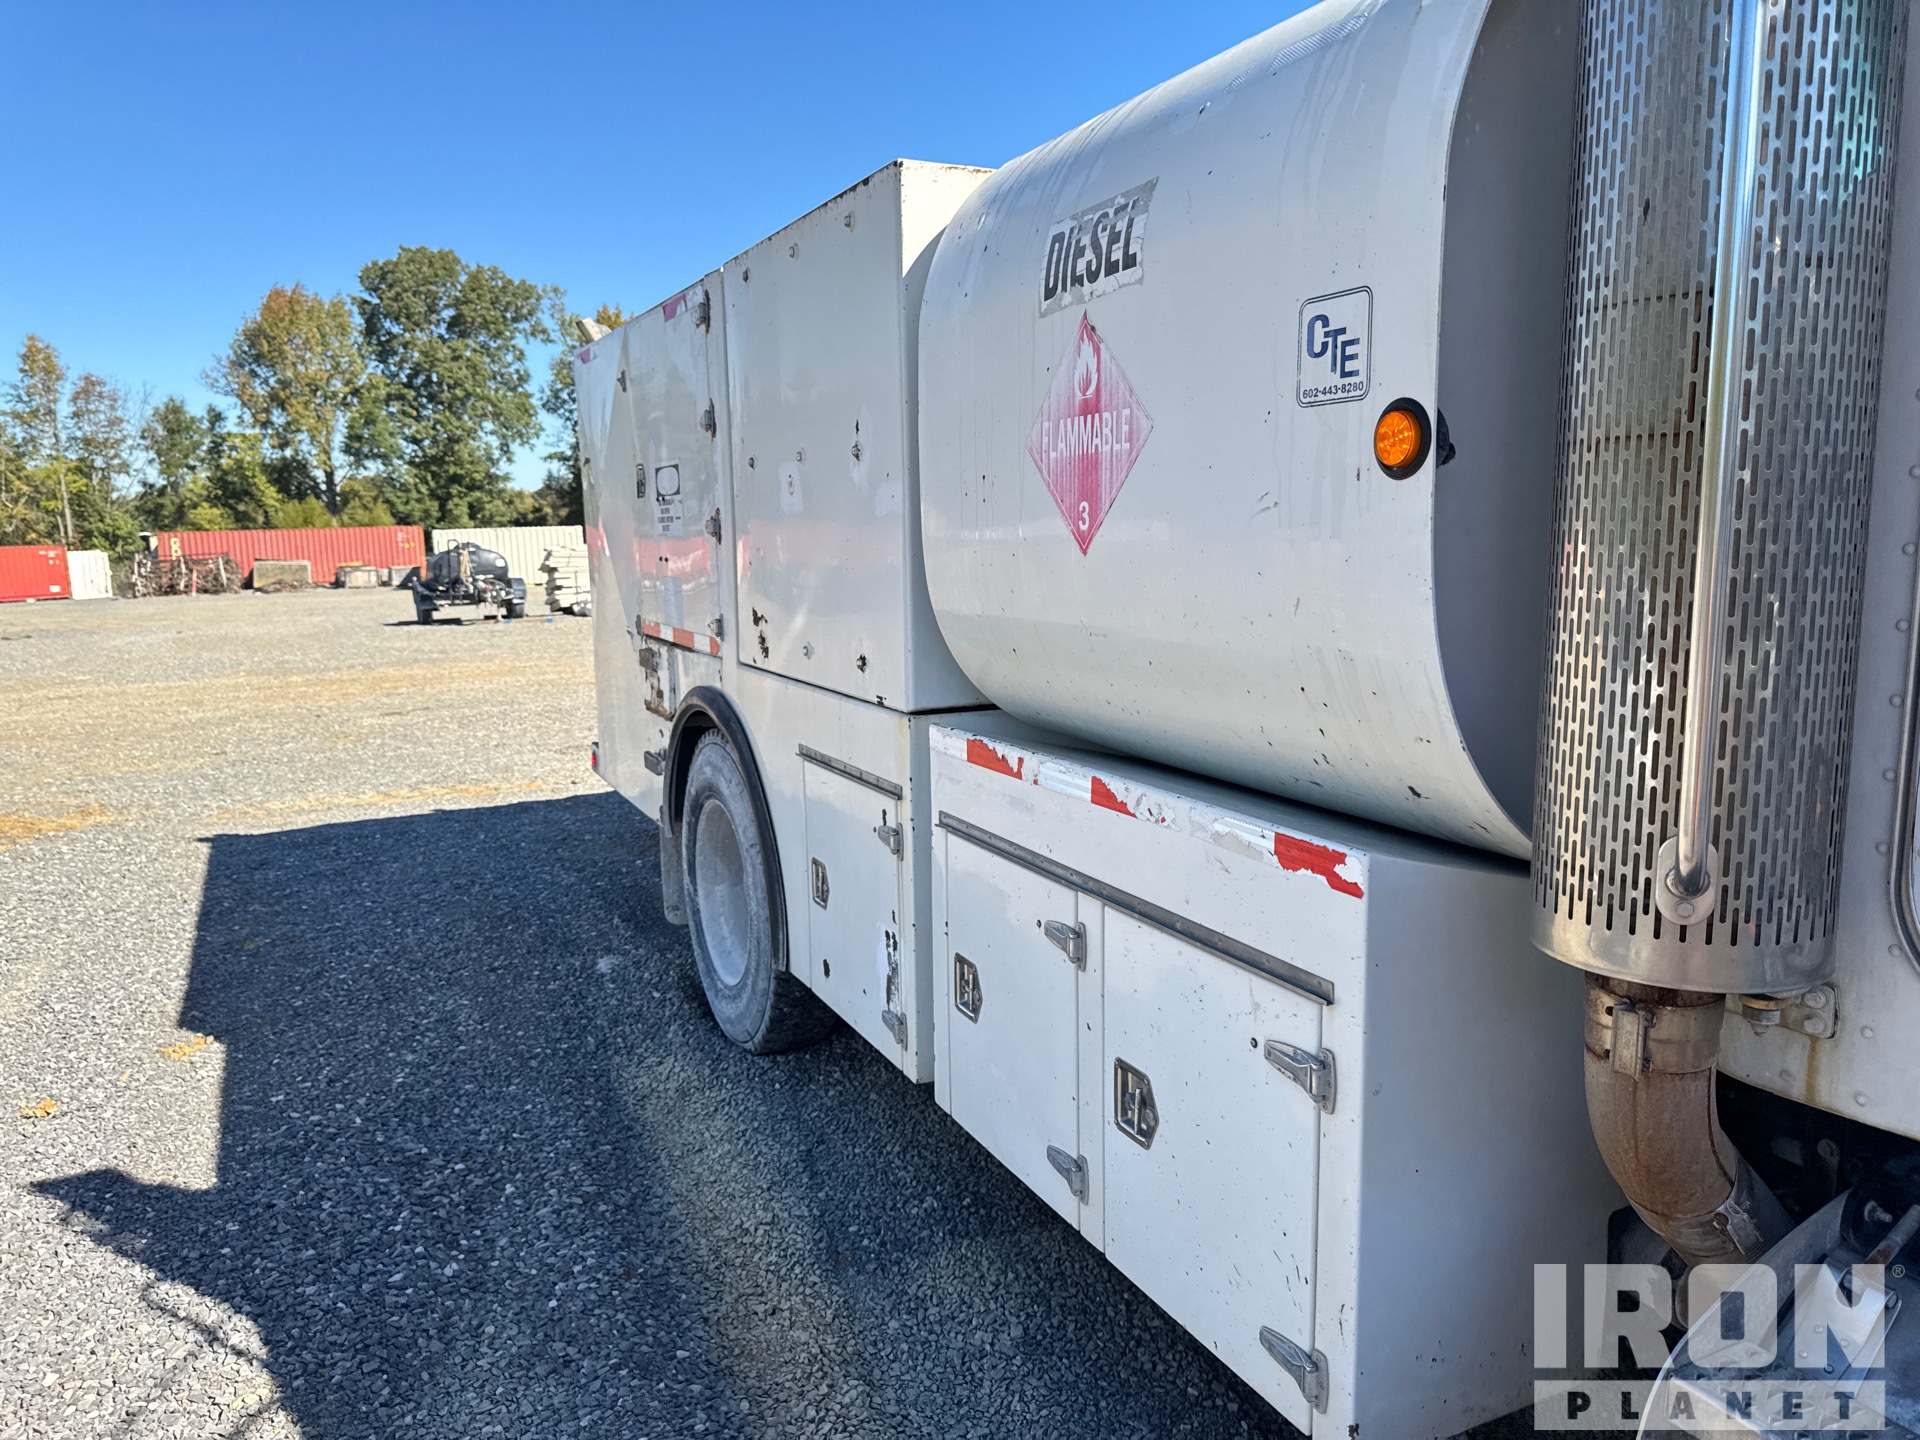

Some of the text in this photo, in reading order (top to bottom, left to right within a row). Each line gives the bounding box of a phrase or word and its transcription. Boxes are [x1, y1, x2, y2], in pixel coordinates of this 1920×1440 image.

[1044, 197, 1140, 302] DIESEL
[1306, 314, 1360, 379] CTE
[1302, 381, 1364, 399] 602-443-8280
[1042, 408, 1131, 458] FLAMMABLE
[1078, 501, 1090, 531] 3
